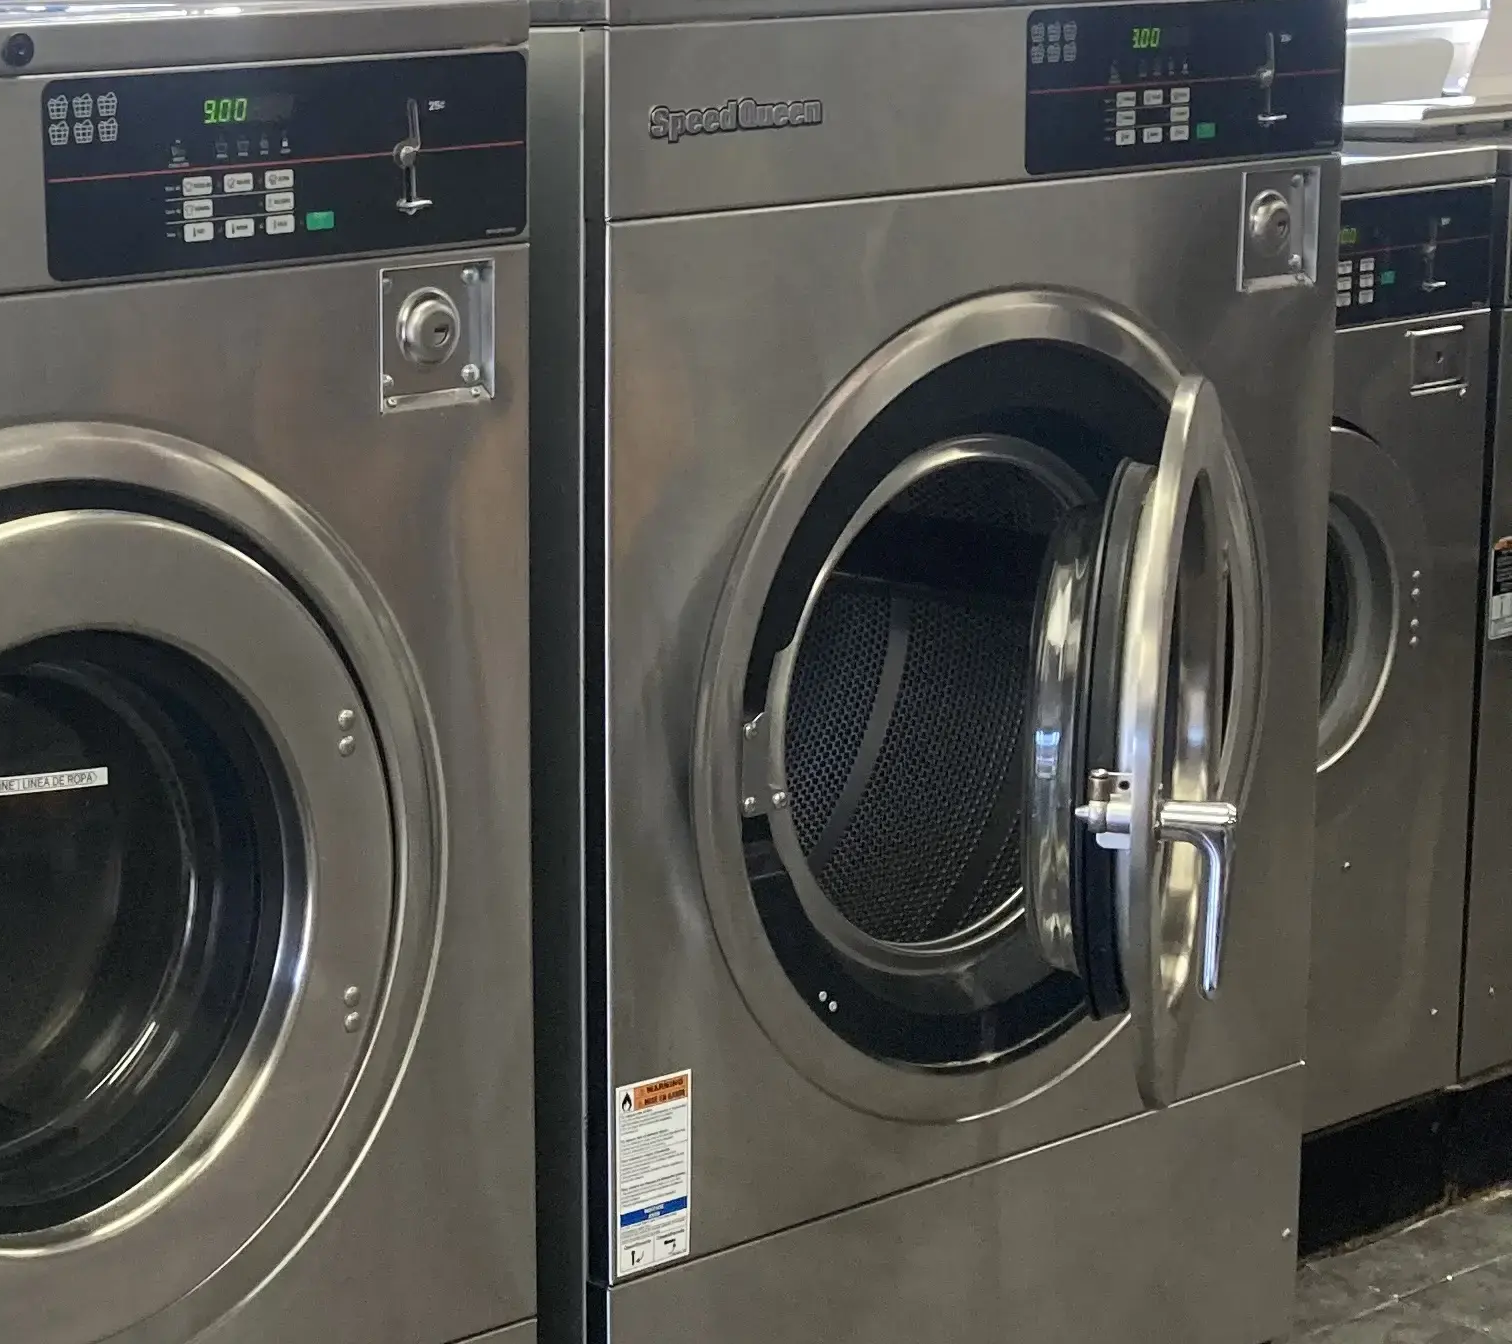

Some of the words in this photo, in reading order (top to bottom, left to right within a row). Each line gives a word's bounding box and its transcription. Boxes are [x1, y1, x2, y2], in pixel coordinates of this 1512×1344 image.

[22, 776, 50, 790] LINEA
[52, 775, 65, 787] DE
[68, 772, 93, 786] ROPA
